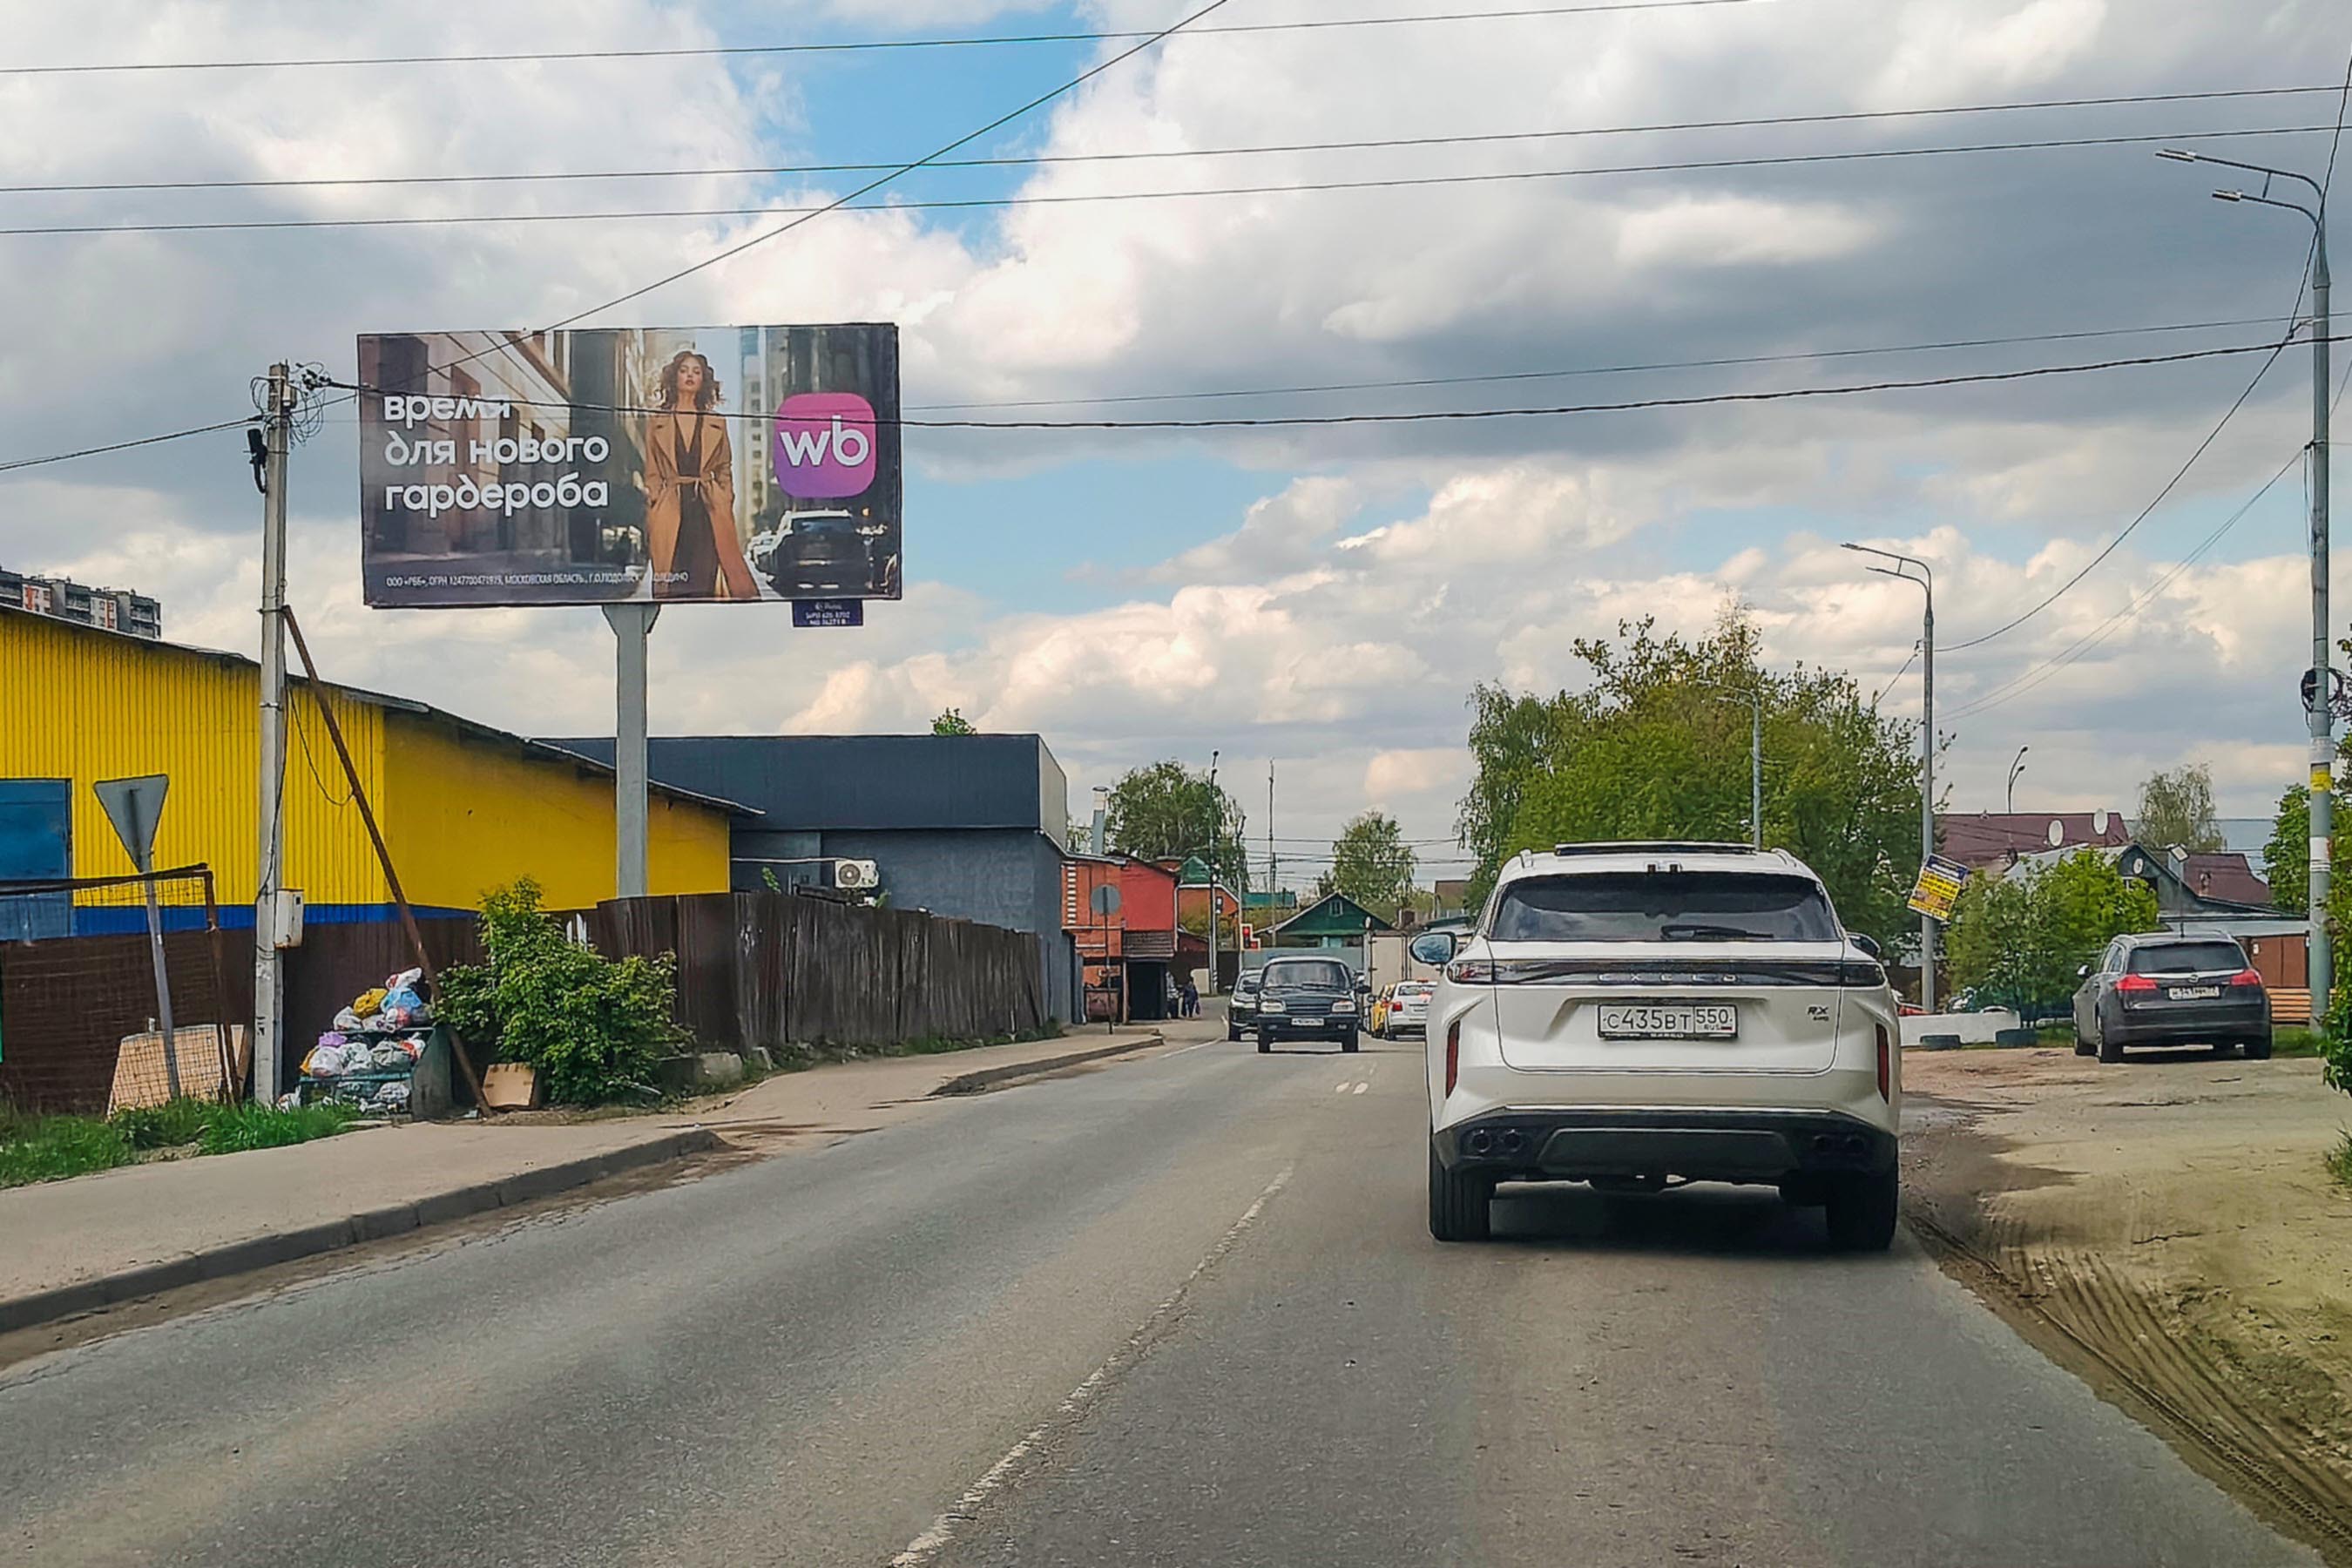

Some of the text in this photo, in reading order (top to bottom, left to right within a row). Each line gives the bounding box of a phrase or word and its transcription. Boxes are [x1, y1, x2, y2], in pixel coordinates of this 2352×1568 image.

[384, 395, 511, 429] время
[384, 431, 610, 466] для нового
[780, 415, 869, 466] wb
[385, 472, 609, 518] гардероба
[386, 576, 403, 587] ООО
[1607, 1009, 1729, 1030] С435ВТ 550
[1808, 1006, 1829, 1015] RX
